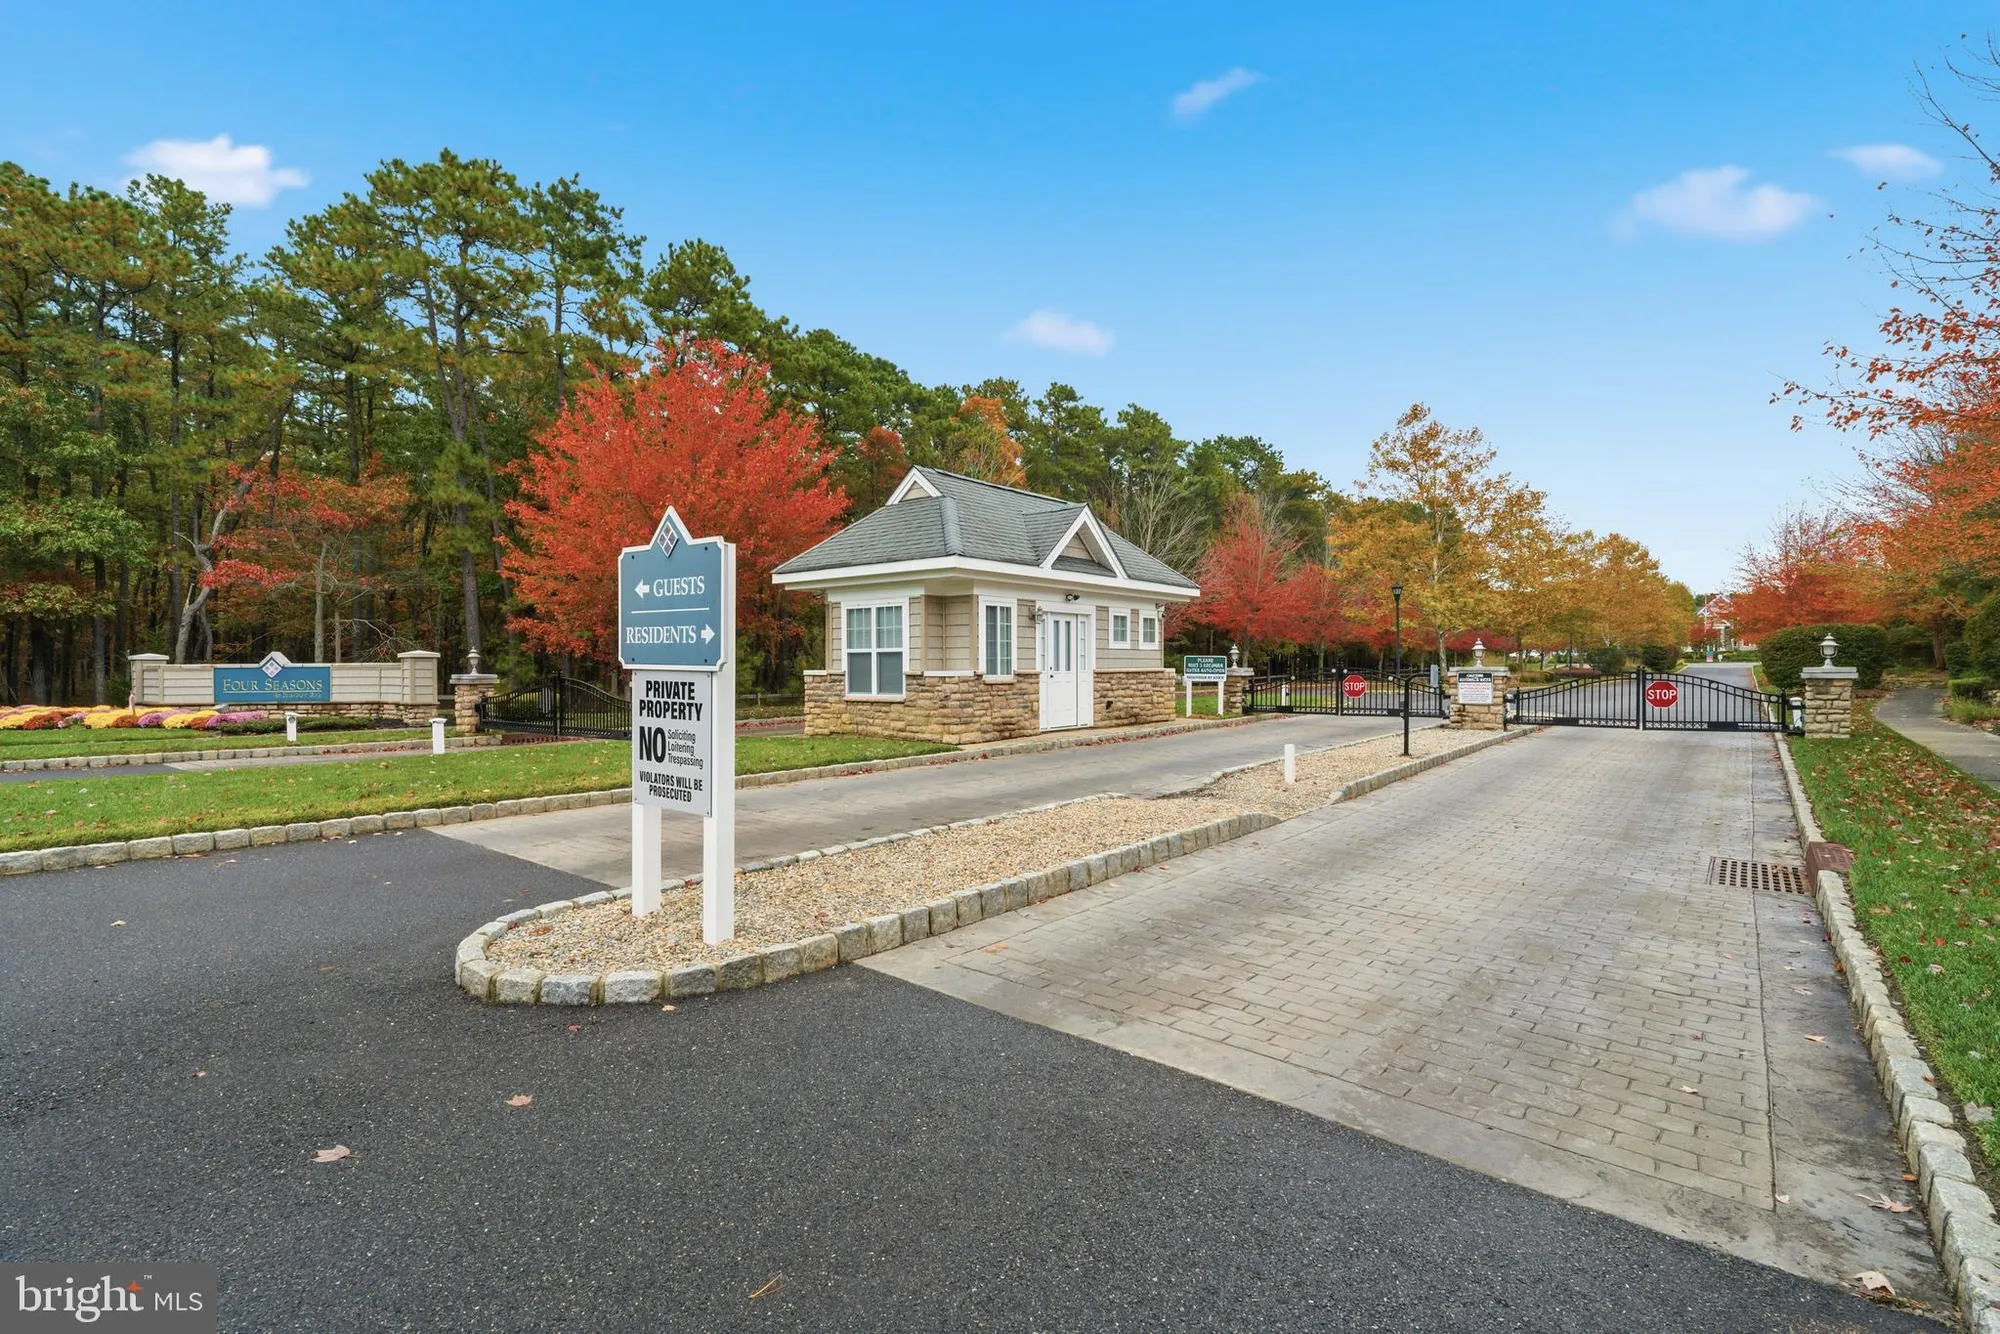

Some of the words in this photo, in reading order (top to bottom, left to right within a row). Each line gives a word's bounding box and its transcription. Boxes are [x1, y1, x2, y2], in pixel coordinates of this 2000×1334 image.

[653, 576, 705, 597] GUESTS
[625, 625, 697, 644] RESIDENTS
[223, 678, 259, 691] FOUR
[265, 678, 323, 691] SEASONS
[645, 680, 696, 700] PRIVATE
[1344, 682, 1365, 691] STOP
[1647, 689, 1677, 700] STOP
[639, 699, 703, 722] PROPERTY
[639, 725, 666, 763] NO
[667, 729, 696, 744] Soliciting
[667, 741, 695, 756] Loitering
[667, 753, 704, 770] Trespassing
[639, 770, 675, 787] VIOLATORS
[675, 776, 693, 790] WILL
[693, 779, 704, 791] BE
[648, 785, 692, 802] PROSECUTED
